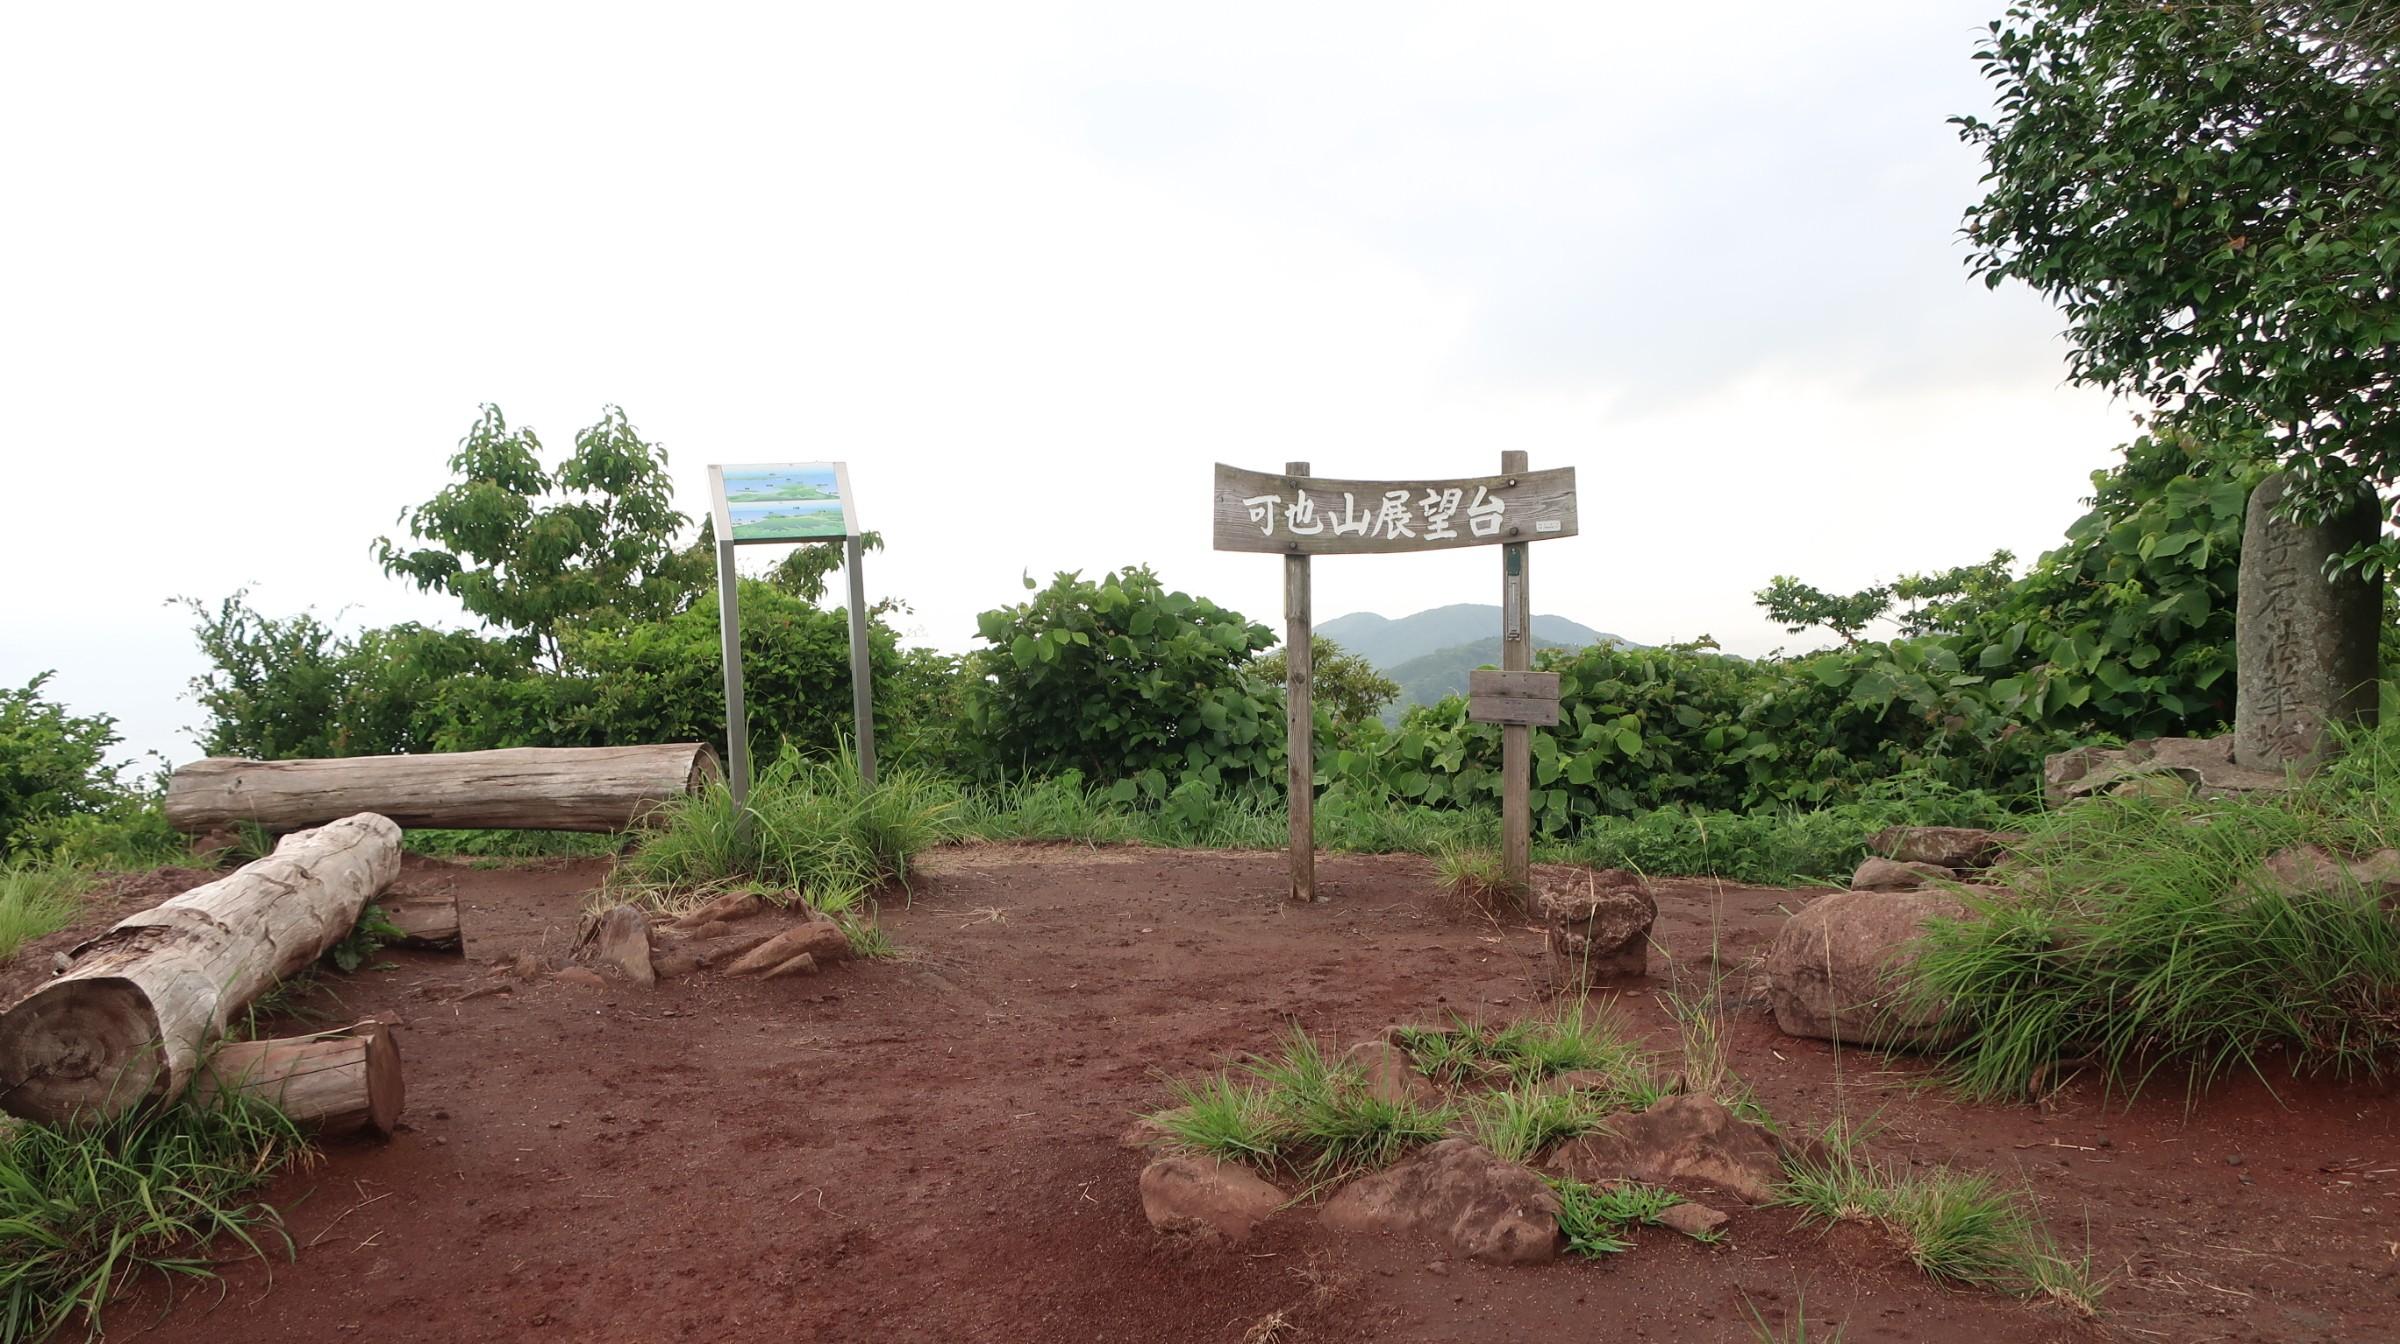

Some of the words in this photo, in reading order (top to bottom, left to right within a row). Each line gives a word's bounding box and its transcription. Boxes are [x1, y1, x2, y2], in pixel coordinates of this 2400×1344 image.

[1243, 486, 1505, 541] 可也山展望台
